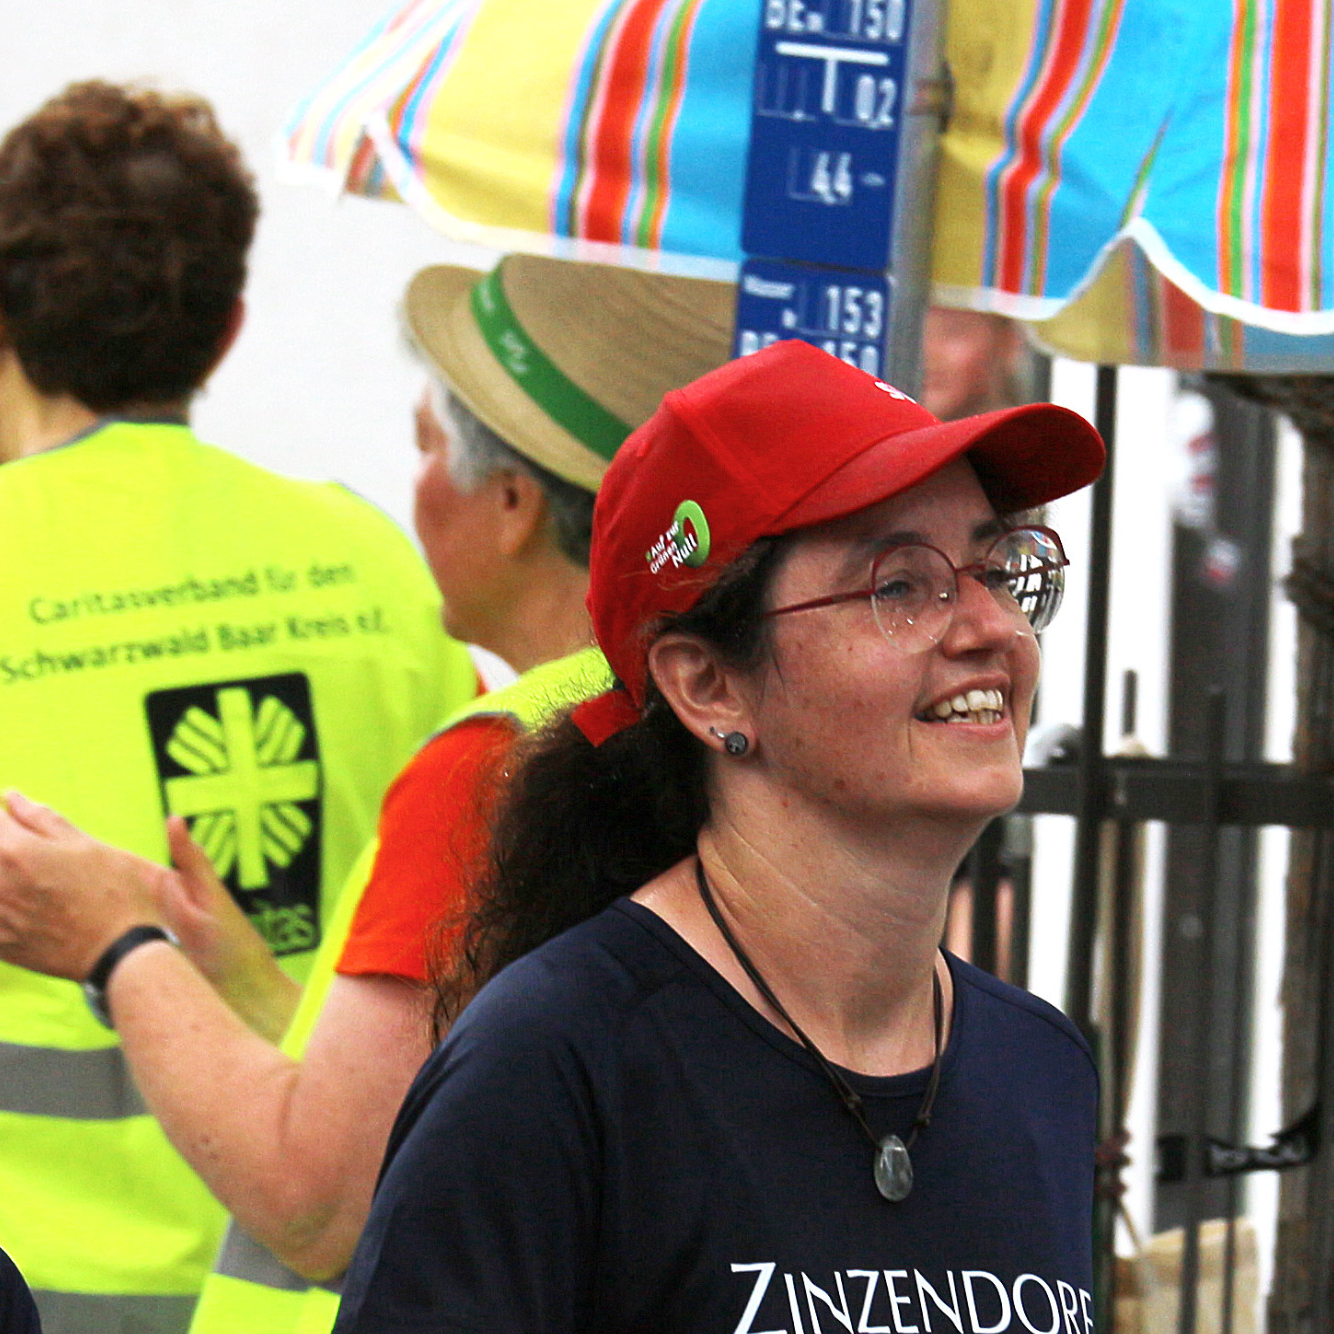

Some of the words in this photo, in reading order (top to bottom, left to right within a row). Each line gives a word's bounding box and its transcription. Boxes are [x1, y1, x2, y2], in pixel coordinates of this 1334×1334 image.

[827, 285, 883, 338] 153
[671, 533, 697, 568] Null
[29, 569, 260, 624] Caritasverband
[307, 558, 355, 589] den
[217, 622, 276, 651] Baar
